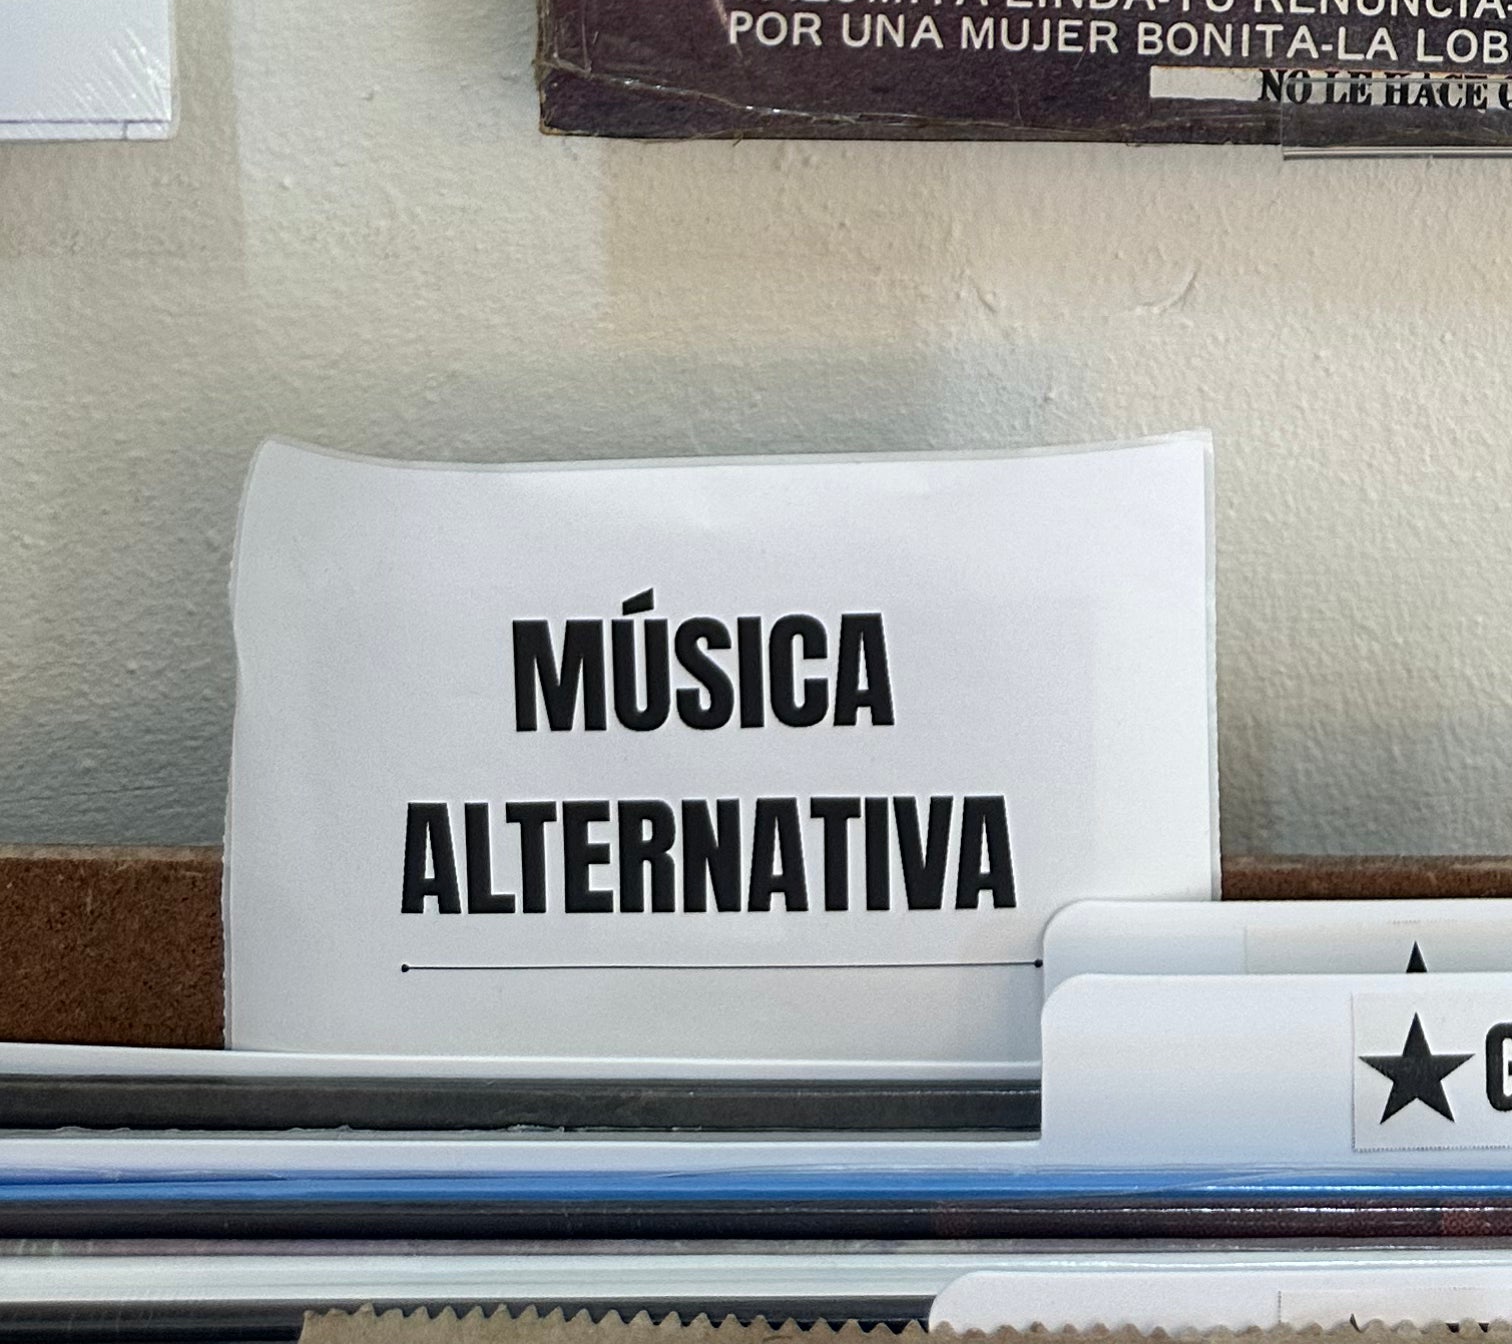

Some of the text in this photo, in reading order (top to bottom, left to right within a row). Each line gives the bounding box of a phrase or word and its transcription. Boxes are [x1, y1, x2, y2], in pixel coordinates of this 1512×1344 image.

[729, 9, 823, 47] POR
[842, 13, 944, 50] UNA
[960, 16, 1119, 54] MUJER
[1137, 20, 1398, 62] BONITA-LA
[1257, 68, 1313, 105] NO
[1325, 70, 1373, 106] LE
[1383, 71, 1488, 111] HACE
[512, 587, 896, 732] MÚSICA
[400, 795, 1018, 914] ALTERNATIVA
